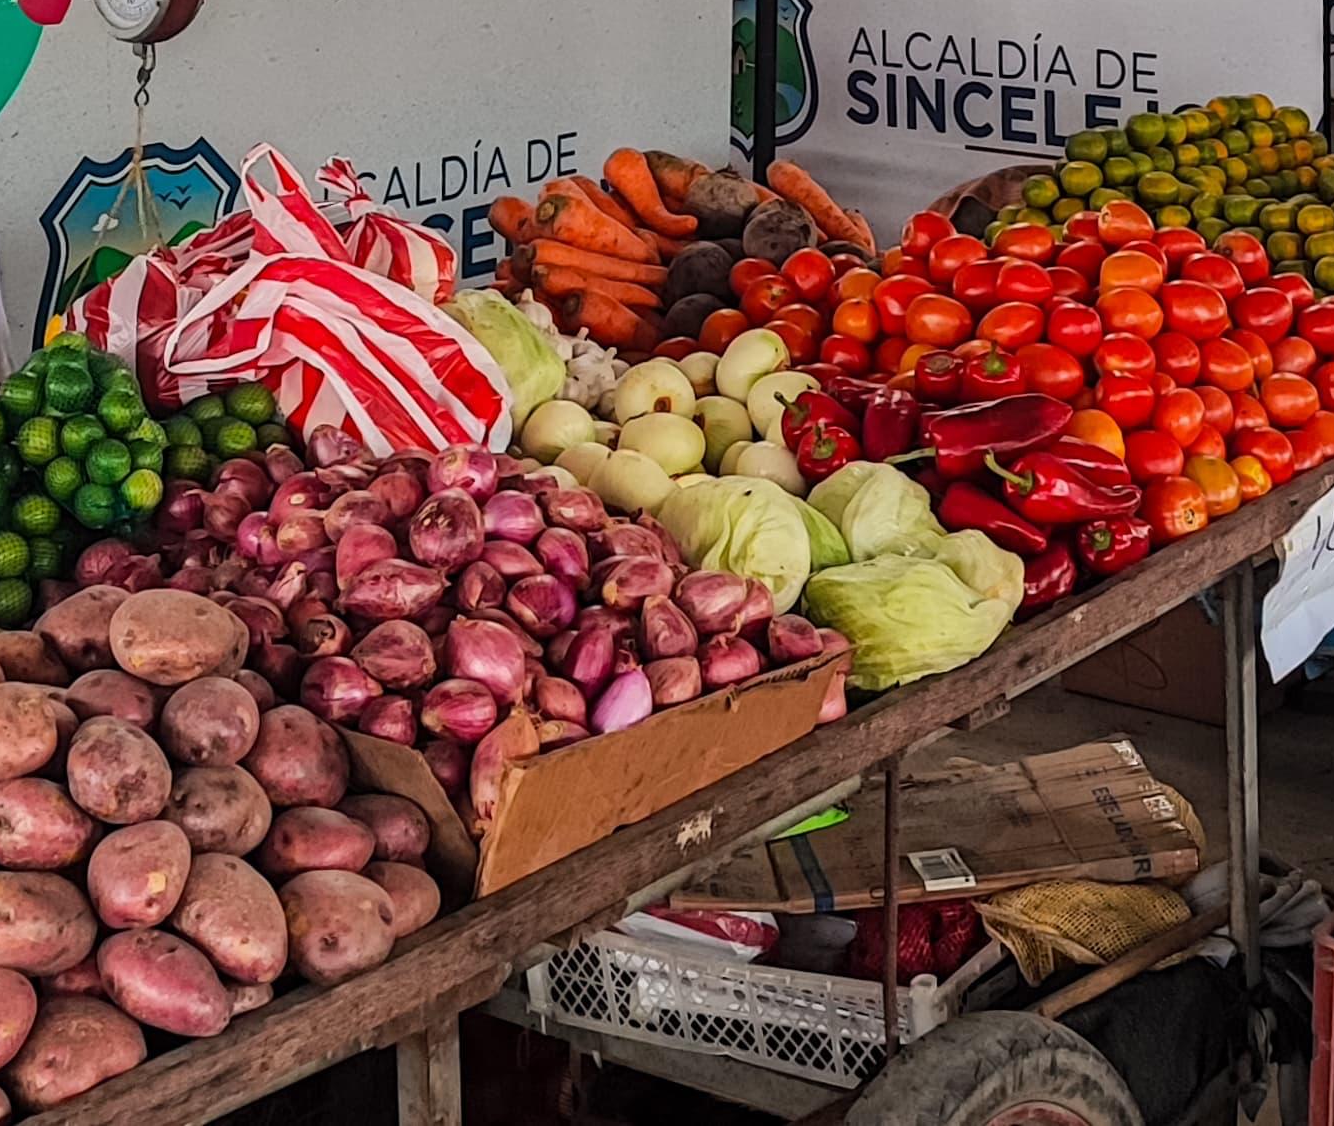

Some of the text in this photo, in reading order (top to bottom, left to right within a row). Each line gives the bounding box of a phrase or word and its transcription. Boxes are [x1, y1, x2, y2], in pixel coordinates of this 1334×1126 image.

[848, 26, 1159, 95] ALCALDÍA DE
[846, 70, 1159, 147] SINCELE
[357, 132, 579, 210] ALDÍA DE
